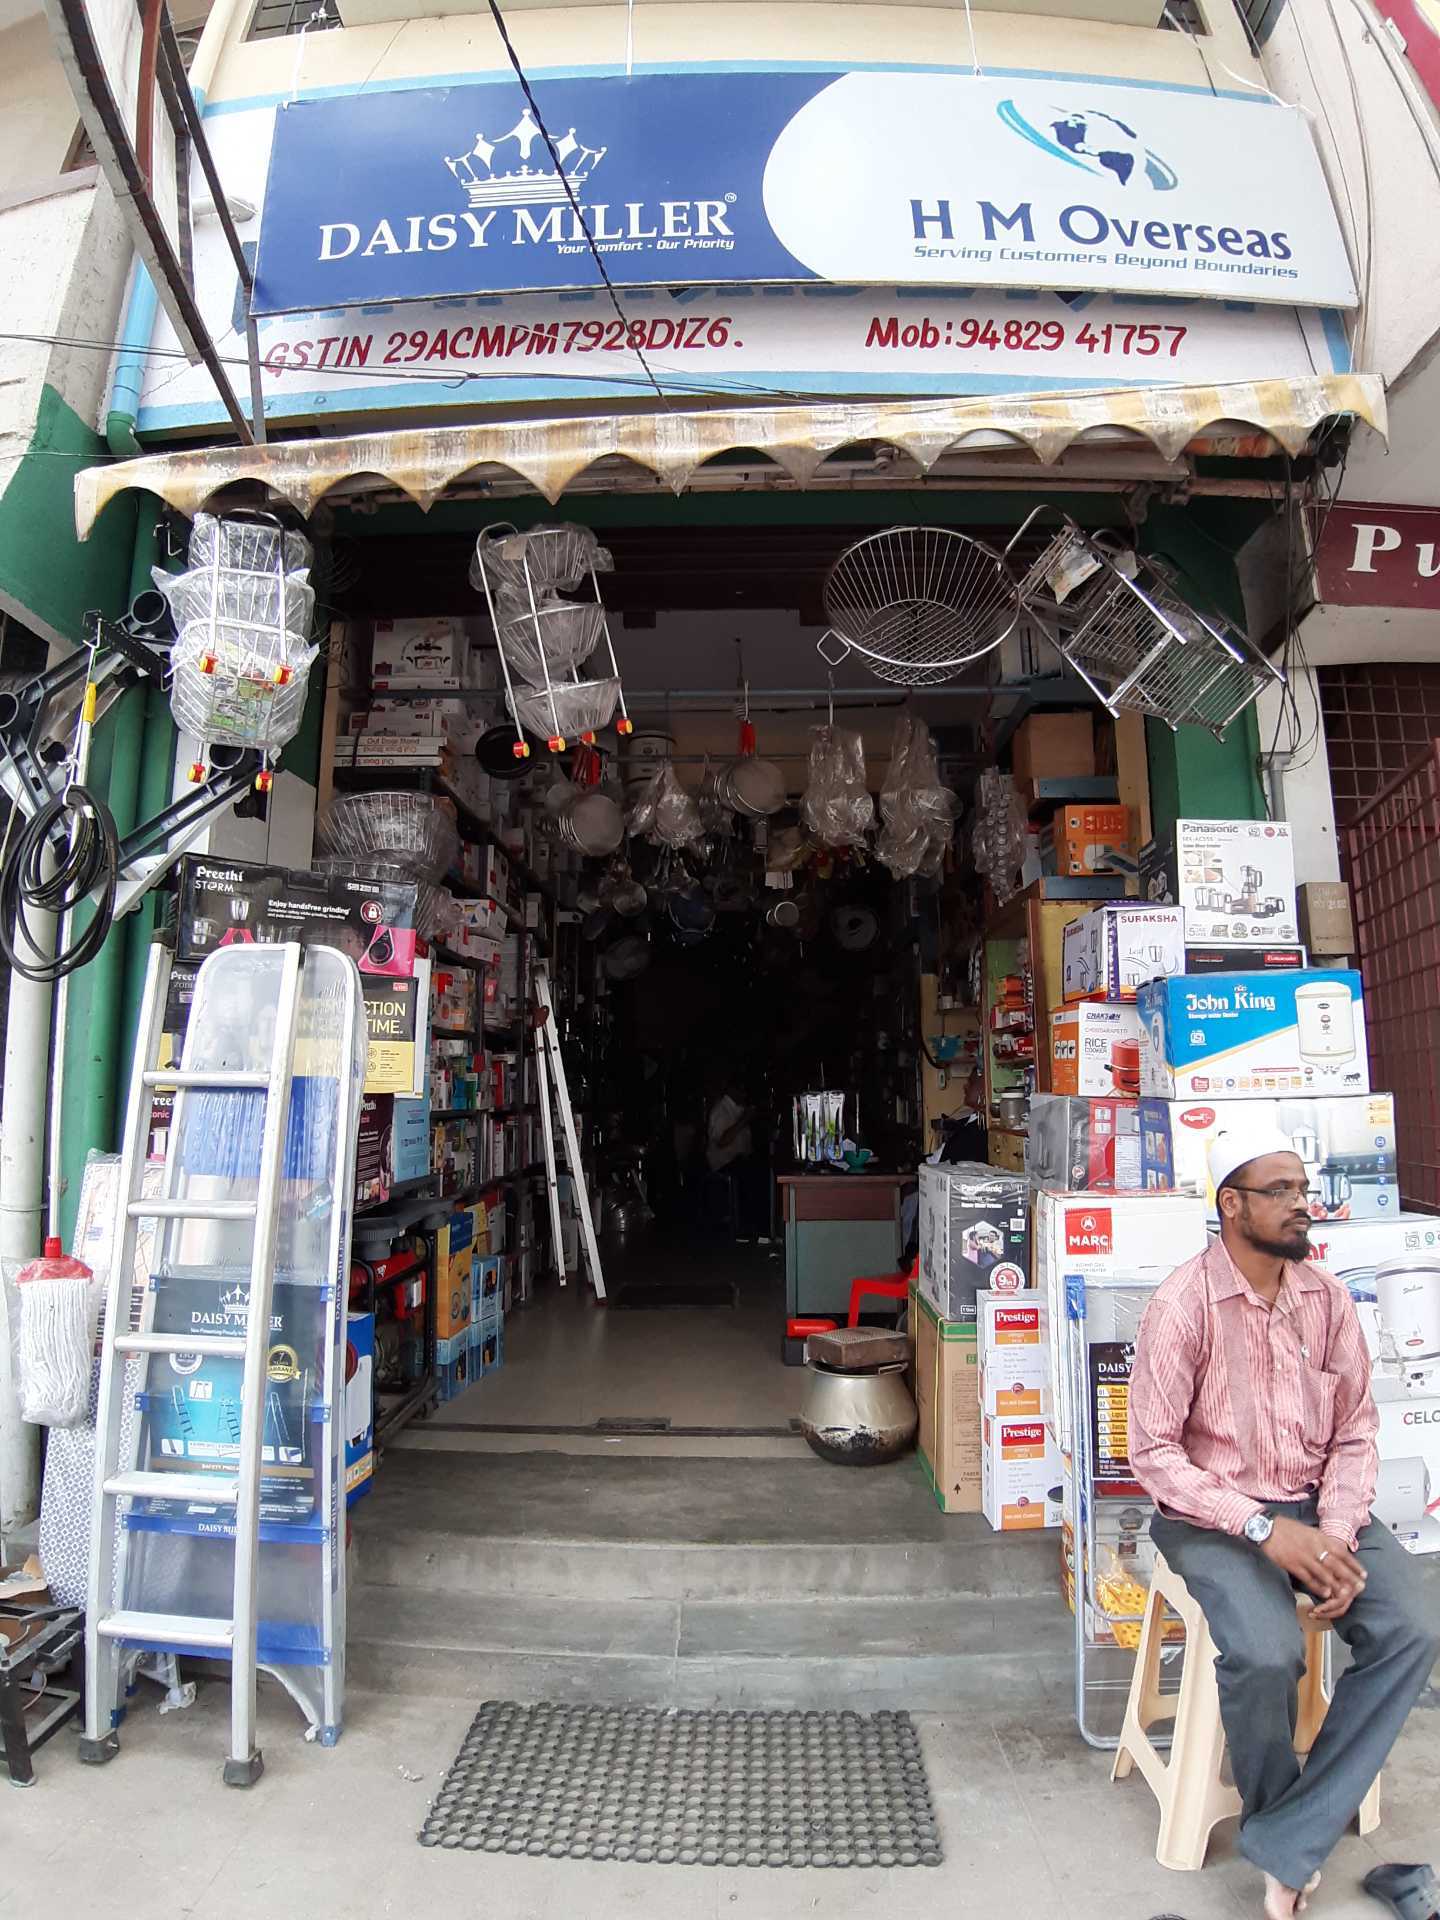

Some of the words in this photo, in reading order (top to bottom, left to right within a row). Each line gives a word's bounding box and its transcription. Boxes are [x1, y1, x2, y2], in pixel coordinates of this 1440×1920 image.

[317, 210, 498, 260] DAISY
[909, 199, 955, 240] H
[976, 201, 1036, 242] M
[1059, 205, 1293, 261] Overseas
[557, 243, 587, 254] Your
[656, 239, 681, 250] Our
[683, 238, 735, 250] Priority
[913, 245, 992, 263] Serving
[999, 247, 1108, 265] Customers
[1114, 253, 1188, 271] Beyond
[1194, 258, 1299, 279] Boundaries
[1075, 322, 1188, 358] 41757
[265, 334, 374, 378] GSTIN
[1181, 823, 1239, 834] Panasonic
[196, 865, 246, 882] Preethi
[268, 899, 288, 909] Enjoy
[1120, 915, 1178, 924] SURAKSHA
[1185, 993, 1229, 1011] John
[1234, 992, 1276, 1011] King
[1084, 1037, 1108, 1048] RICE
[1068, 1234, 1110, 1247] MARC
[192, 1311, 232, 1325] DAISY
[996, 1311, 1036, 1323] Prestige
[1098, 1363, 1133, 1374] DAISY
[1002, 1427, 1042, 1438] Prestige
